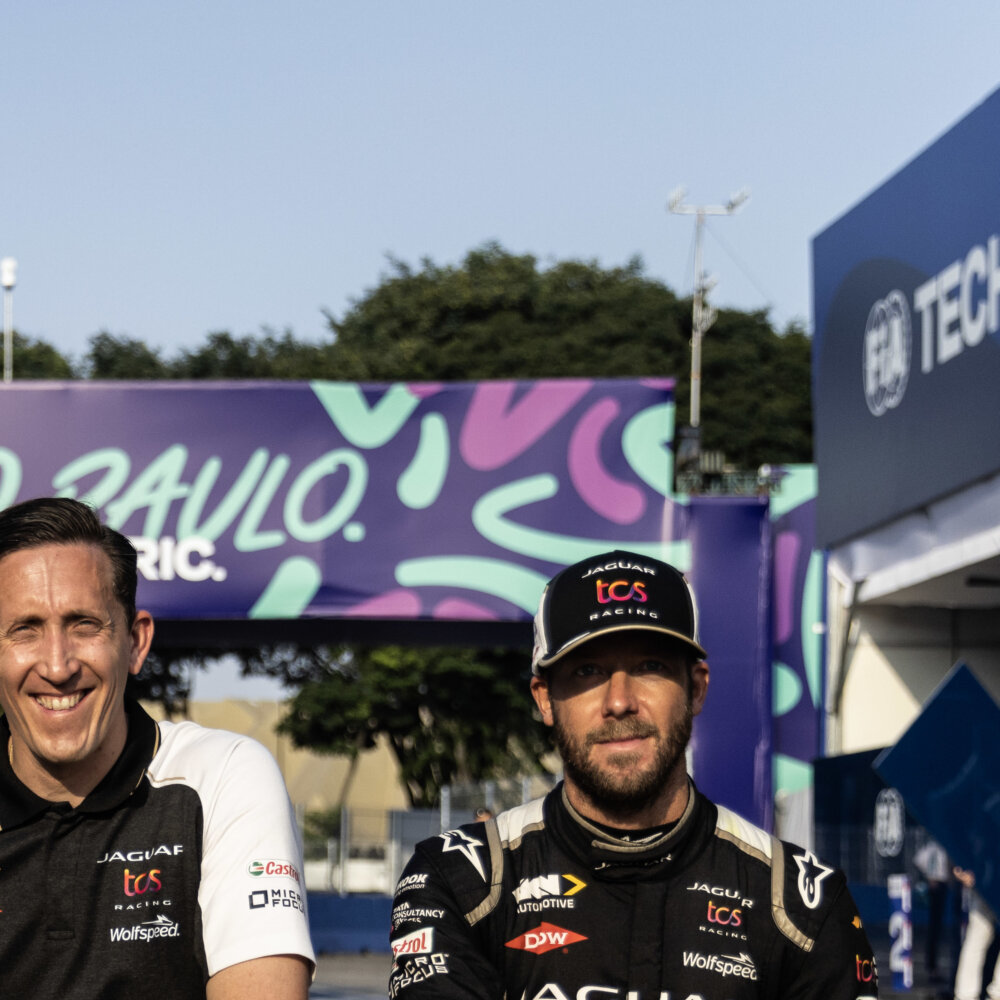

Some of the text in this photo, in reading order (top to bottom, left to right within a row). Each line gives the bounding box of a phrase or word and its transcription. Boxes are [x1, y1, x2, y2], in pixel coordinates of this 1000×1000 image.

[581, 562, 656, 579] JAGUAR
[596, 579, 648, 604] tcs
[589, 608, 659, 621] RACING
[265, 861, 299, 882] Castro
[124, 868, 162, 897] tcs
[114, 899, 172, 911] RACING
[687, 882, 754, 909] JAGUR
[707, 901, 742, 927] tcs
[699, 925, 747, 941] RACING
